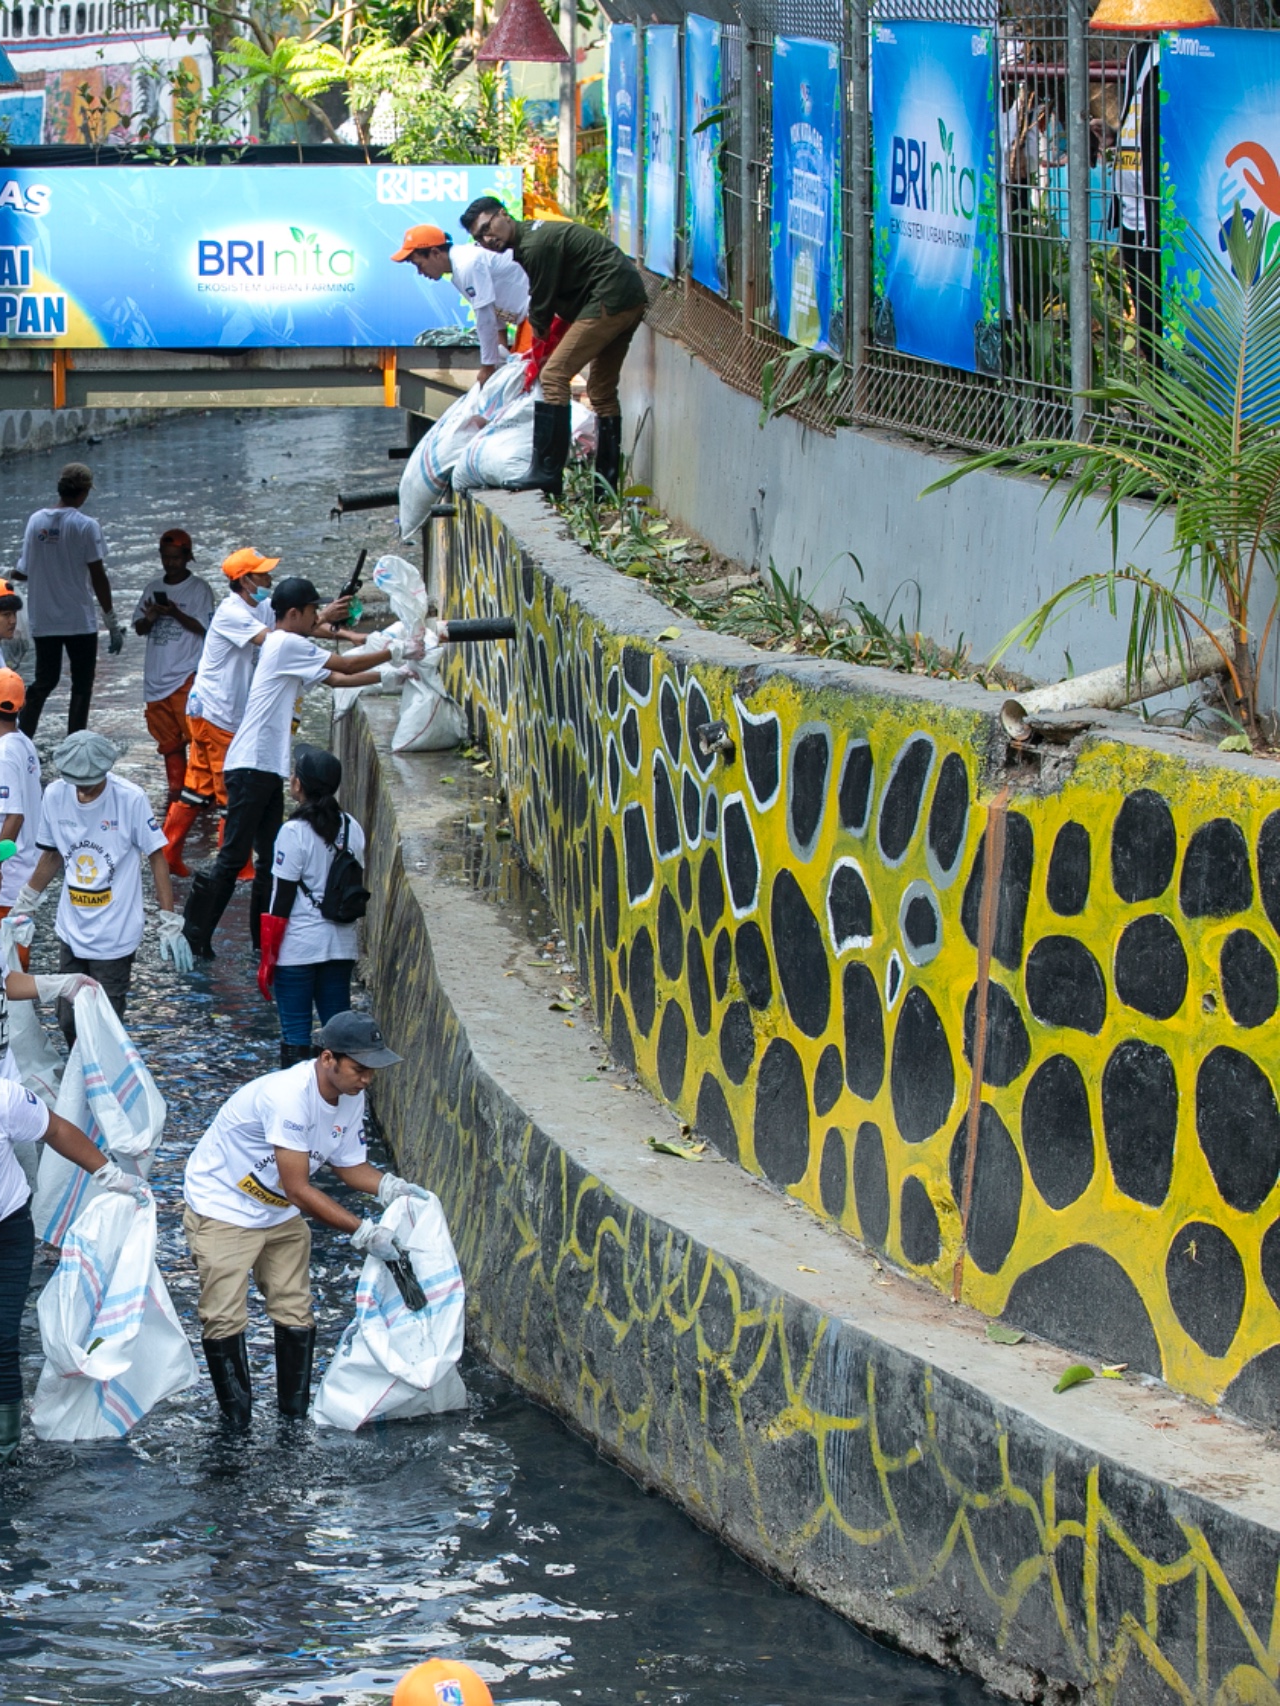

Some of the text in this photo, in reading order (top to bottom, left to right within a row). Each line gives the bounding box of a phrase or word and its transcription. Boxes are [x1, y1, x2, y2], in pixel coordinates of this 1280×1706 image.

[414, 170, 468, 202] BRI
[890, 136, 928, 211] BRI
[198, 240, 356, 277] BRI nita
[197, 282, 262, 293] EKOSISTEM
[253, 1153, 276, 1172] SAMP
